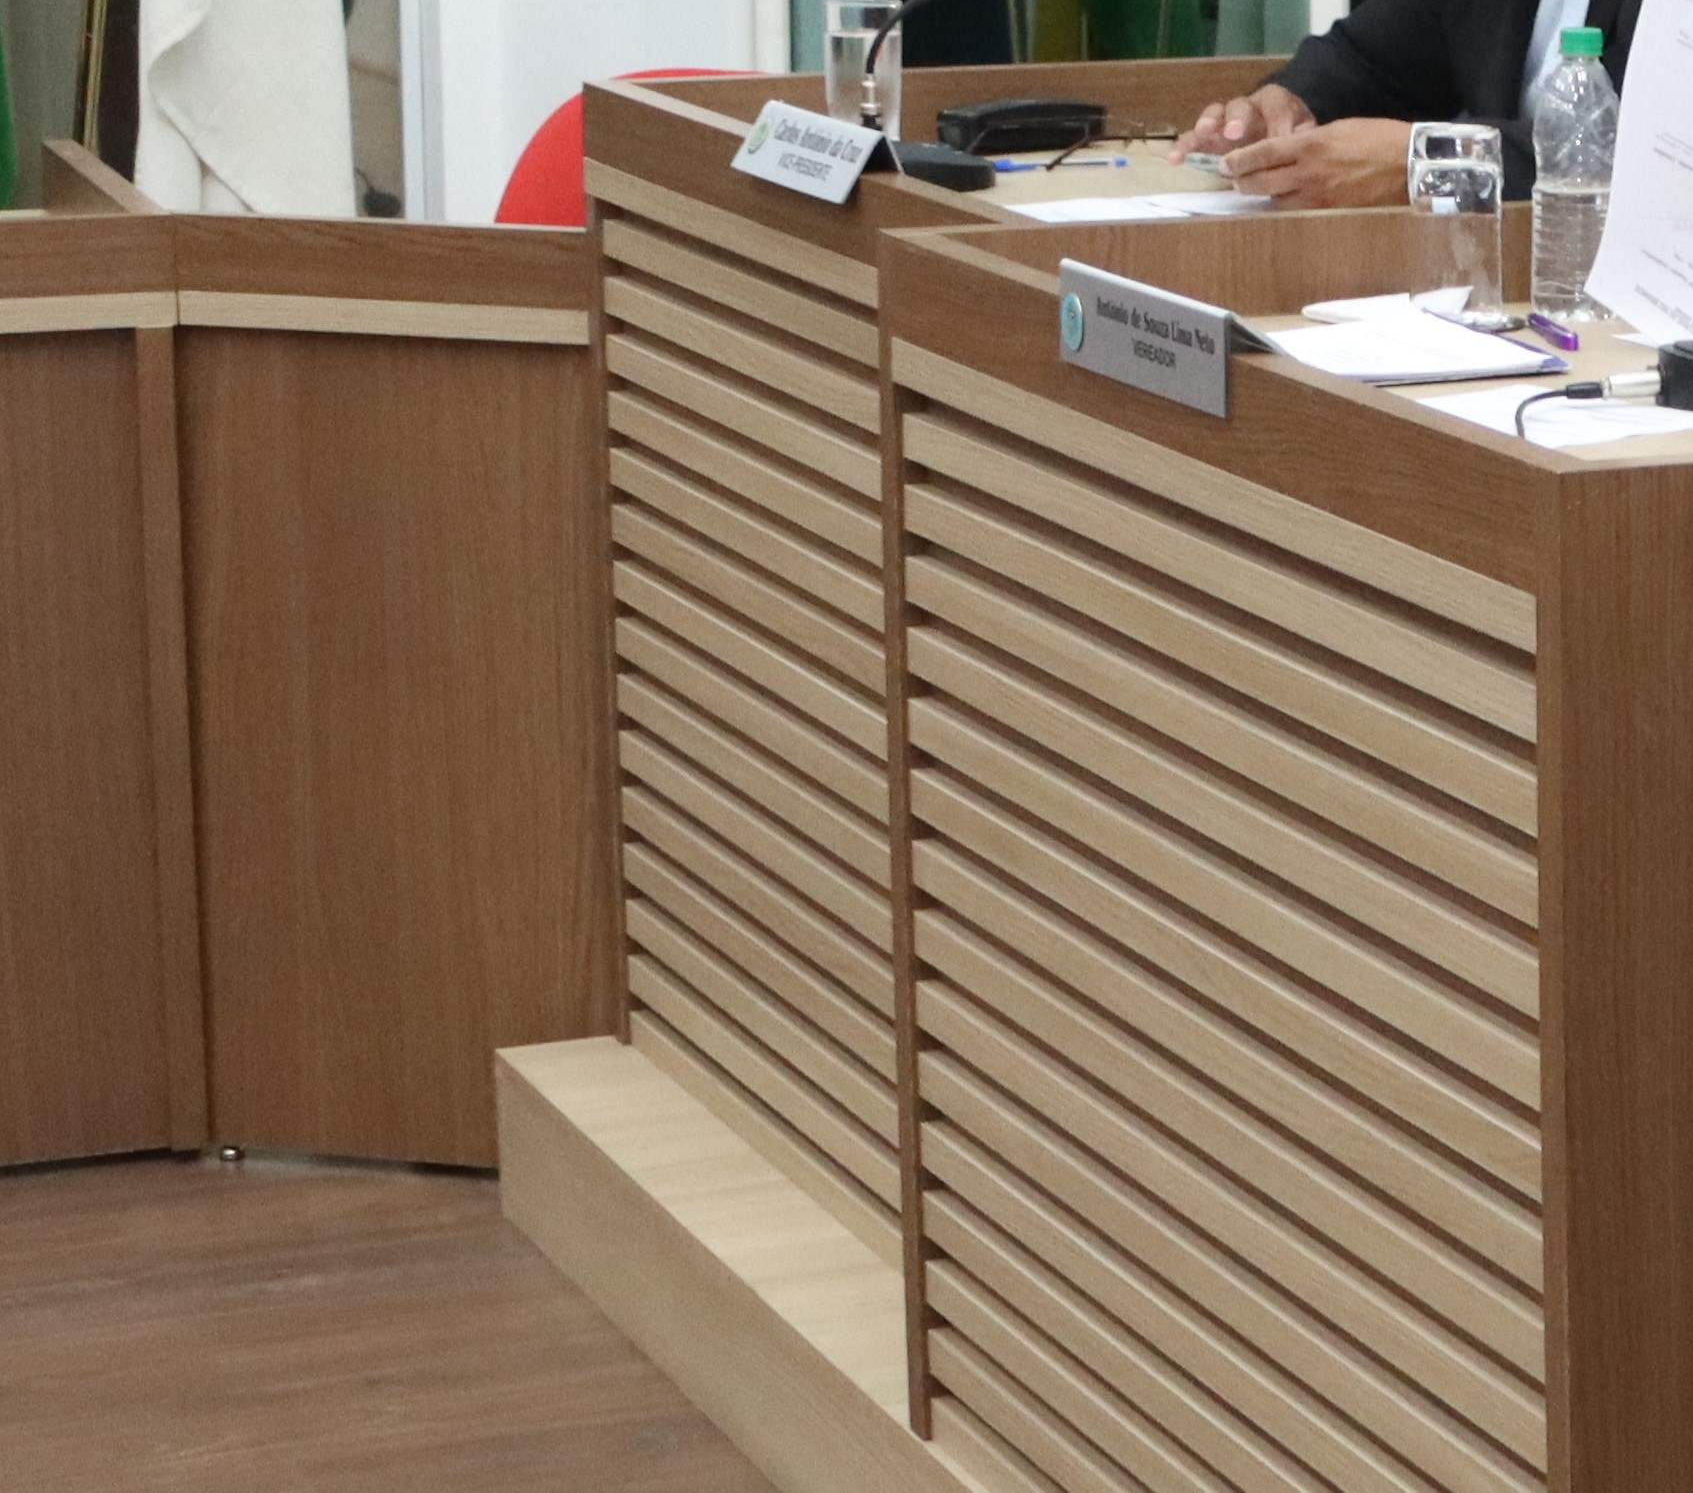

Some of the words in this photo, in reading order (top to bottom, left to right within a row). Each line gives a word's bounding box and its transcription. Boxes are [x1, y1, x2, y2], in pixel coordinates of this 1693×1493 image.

[1131, 306, 1142, 329] de
[1144, 311, 1170, 339] Souza
[1171, 320, 1193, 348] Lima
[1194, 328, 1215, 356] Neto
[1132, 337, 1178, 370] VEREADOR
